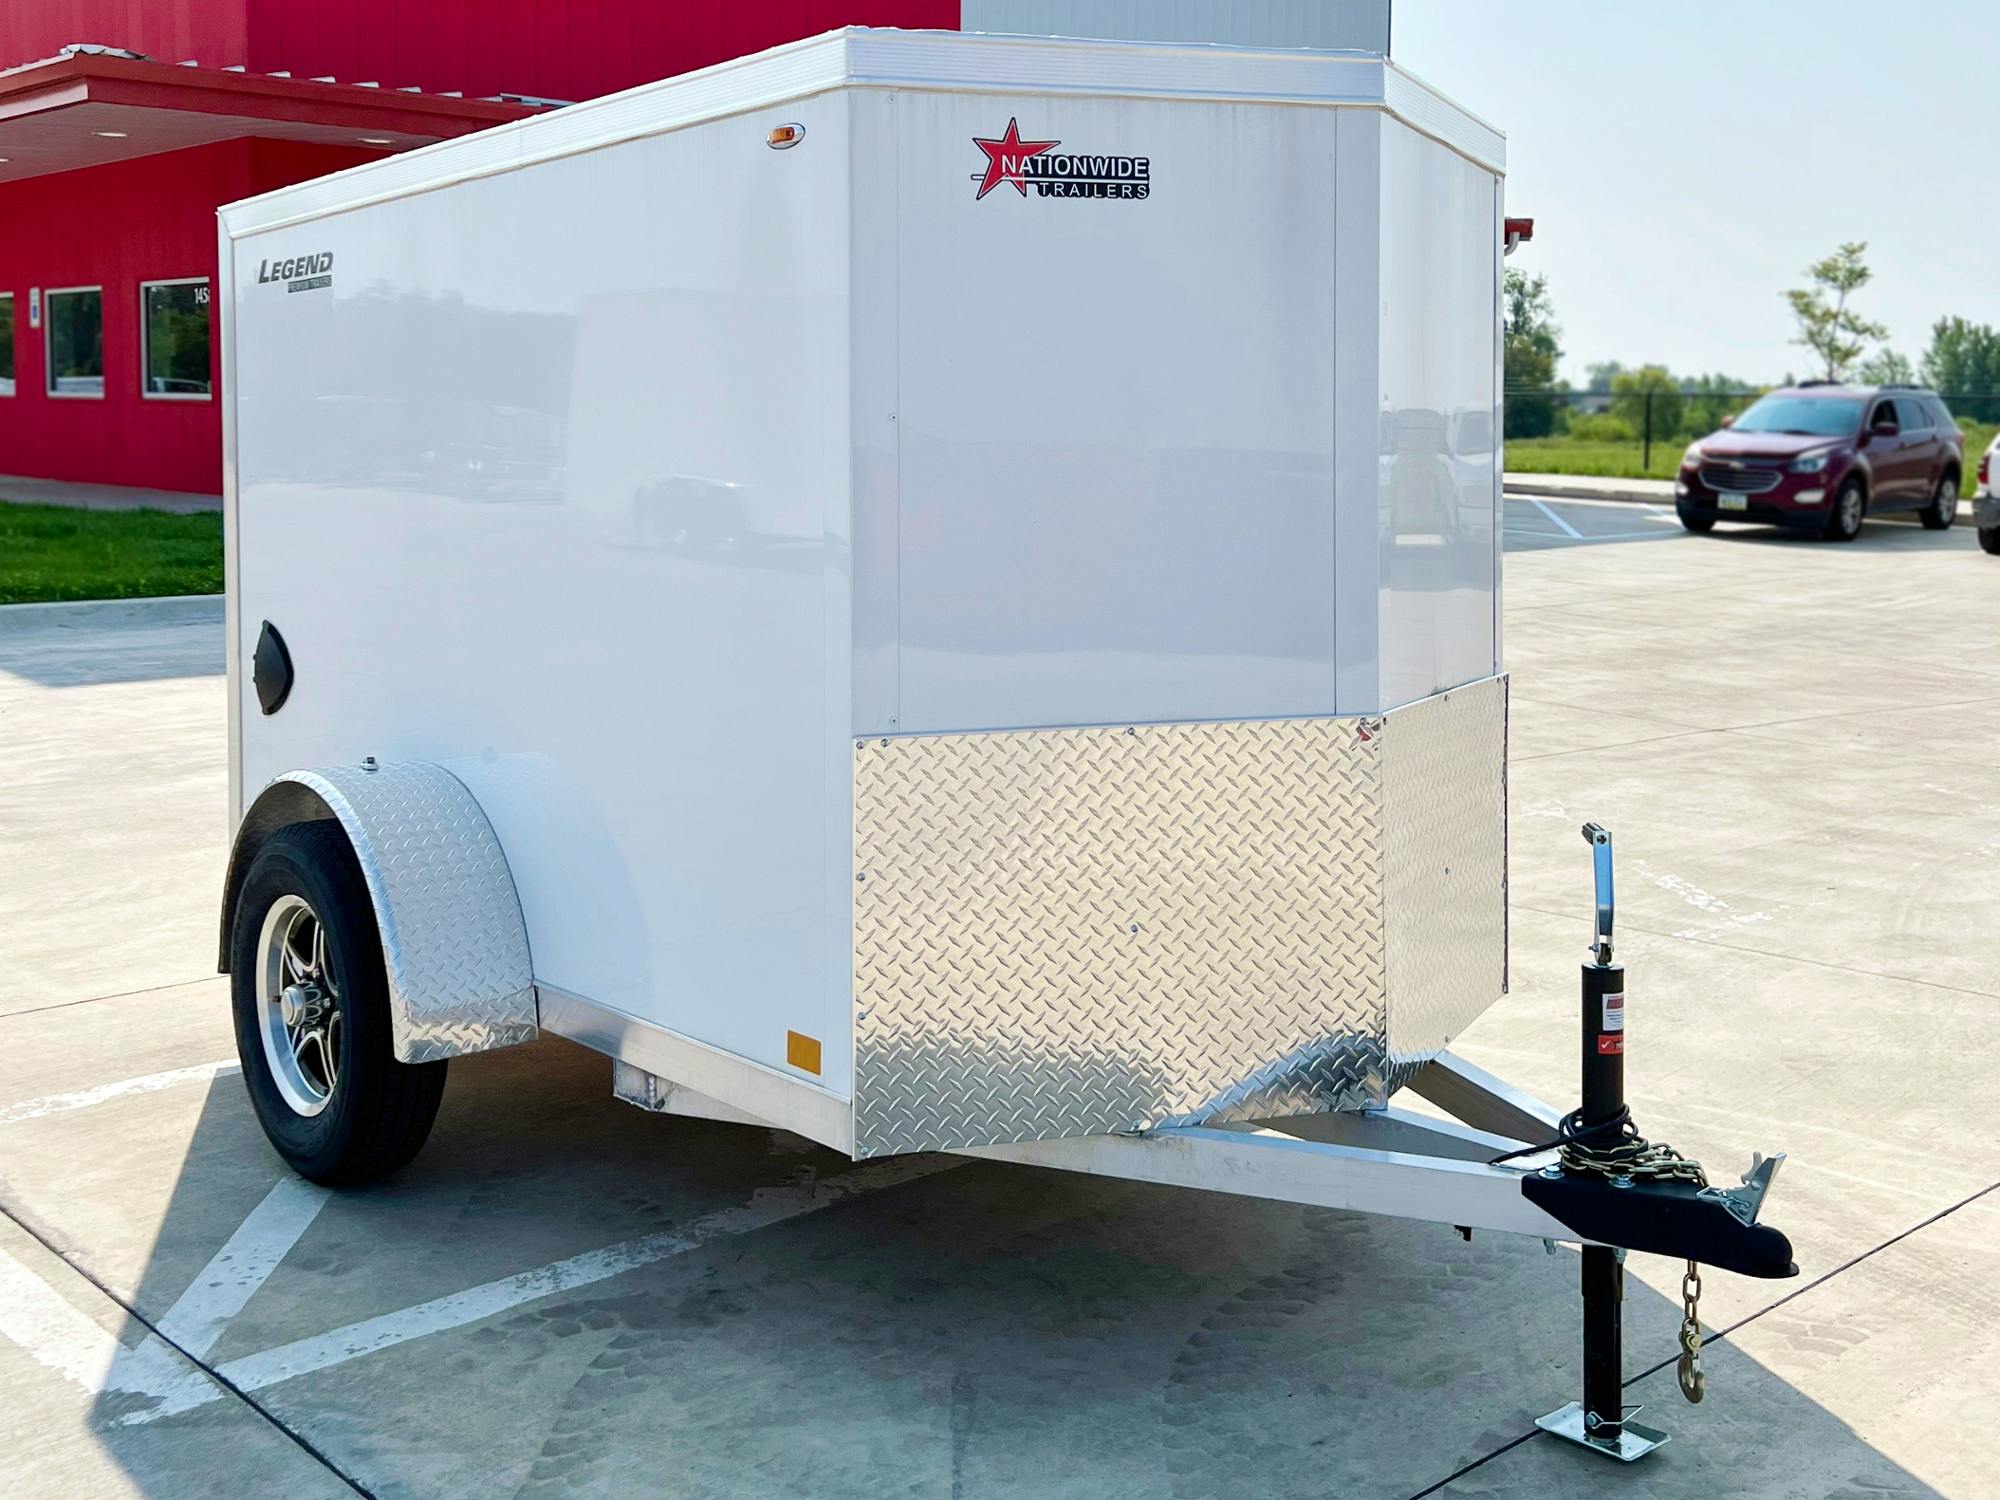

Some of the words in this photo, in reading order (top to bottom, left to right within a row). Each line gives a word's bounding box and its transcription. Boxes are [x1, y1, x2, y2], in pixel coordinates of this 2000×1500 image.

[1001, 154, 1148, 178] NATIONWIDE
[1040, 182, 1147, 198] TRAILERS
[258, 252, 334, 284] LEGEND
[194, 287, 210, 304] 145
